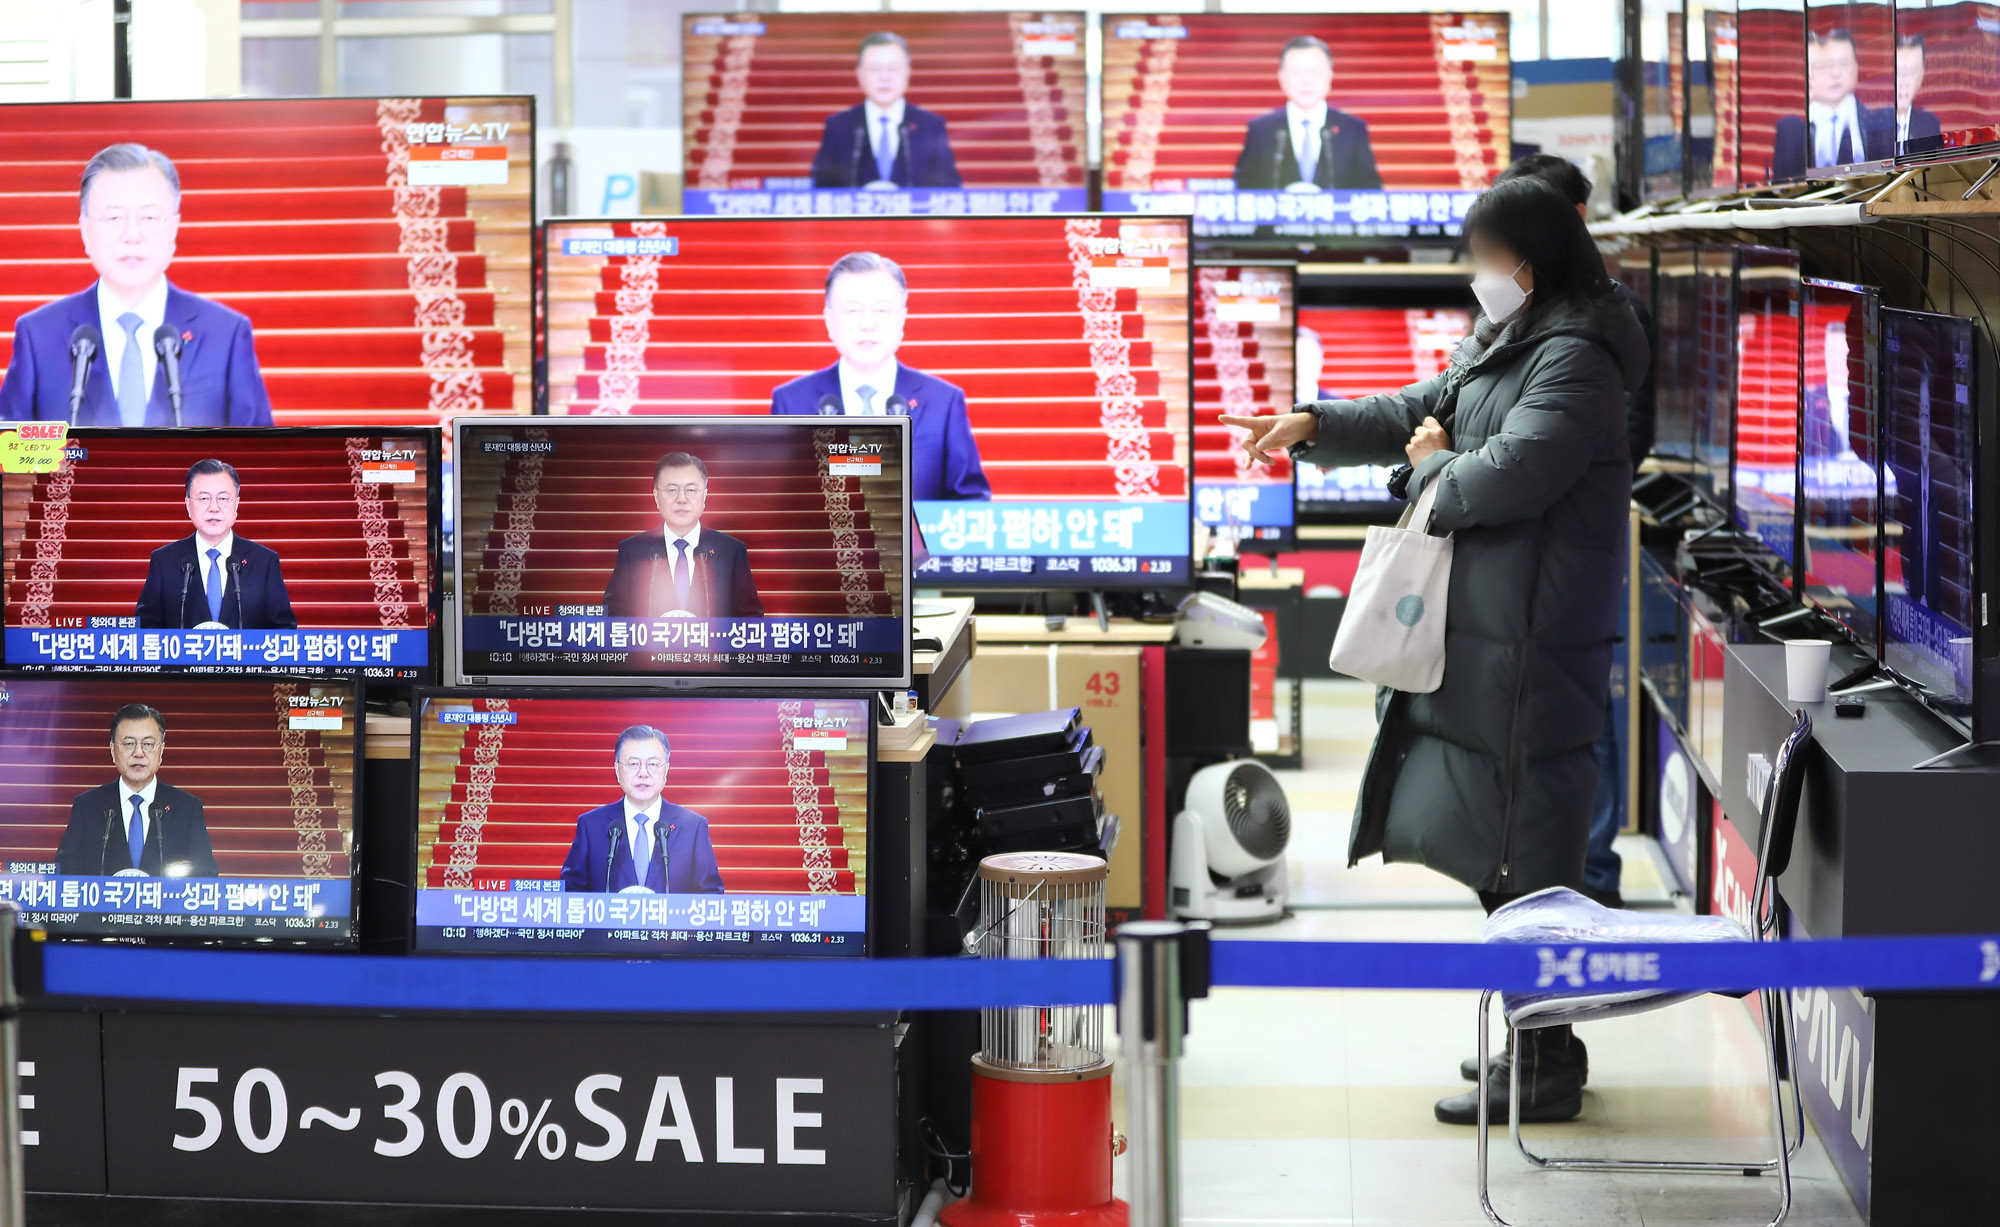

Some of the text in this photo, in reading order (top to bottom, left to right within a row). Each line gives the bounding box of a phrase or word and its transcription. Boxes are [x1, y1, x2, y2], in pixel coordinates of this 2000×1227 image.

[405, 122, 510, 143] 연합뉴스TV
[20, 425, 64, 438] SALE!
[484, 443, 551, 452] 문재인 대통령 신년사
[828, 443, 882, 454] 연합뉴스TV
[361, 450, 416, 460] 연합뉴스TV
[1002, 508, 1062, 550] 폄하
[1066, 509, 1098, 550] 안
[1090, 558, 1137, 573] 1036.31
[1150, 560, 1172, 573] 2.33
[523, 605, 604, 616] LIVE 청와대 본관
[56, 617, 136, 628] LIVE 청와대 본관
[500, 620, 562, 647] "다방면
[567, 621, 605, 647] 세계
[609, 622, 648, 647] 톱10
[770, 623, 810, 648] 폄하
[813, 623, 833, 648] 안
[837, 621, 864, 648] 돼"
[32, 632, 96, 660] "다방면
[99, 632, 138, 661] 세계
[142, 633, 180, 660] 톱10
[304, 634, 344, 662] 폄하
[347, 634, 368, 662] 안
[371, 634, 398, 662] 돼"
[489, 653, 512, 662] 10:10
[582, 652, 598, 663] 정서
[657, 653, 691, 663] 아파트값
[693, 653, 710, 663] 격차
[756, 653, 792, 664] 파르크한
[801, 655, 822, 664] 코스닥
[829, 655, 860, 664] 1036.31
[363, 668, 394, 678] 1036.31
[1086, 672, 1120, 695] 43
[288, 696, 344, 707] 연합뉴스TV
[444, 713, 512, 723] 문재인 대통령 신년사
[793, 717, 848, 728] 연합뉴스TV
[10, 863, 36, 873] 청와대
[38, 864, 56, 874] 본관
[478, 880, 561, 892] LIVE 청와대 본관
[17, 880, 56, 907] 세계
[61, 881, 99, 907] 톱10
[269, 884, 289, 911] 안
[293, 884, 320, 912] 돼"
[454, 895, 518, 922] "다방면
[522, 896, 561, 923] 세계
[566, 897, 605, 924] 톱10
[731, 899, 771, 926] 폄하
[774, 899, 794, 926] 안
[799, 899, 826, 927] 돼"
[32, 913, 48, 923] 정서
[108, 915, 142, 925] 아파트값
[145, 915, 162, 925] 격차
[209, 916, 246, 927] 파르크한
[255, 918, 276, 927] 코스닥
[284, 918, 315, 928] 1036.31
[325, 921, 339, 929] 2.33
[442, 928, 466, 938] 10:10
[537, 929, 553, 939] 정서
[614, 931, 648, 941] 아파트값
[651, 931, 668, 941] 격차
[760, 933, 782, 942] 코스닥
[790, 933, 821, 943] 1036.31
[830, 936, 845, 944] 2.33
